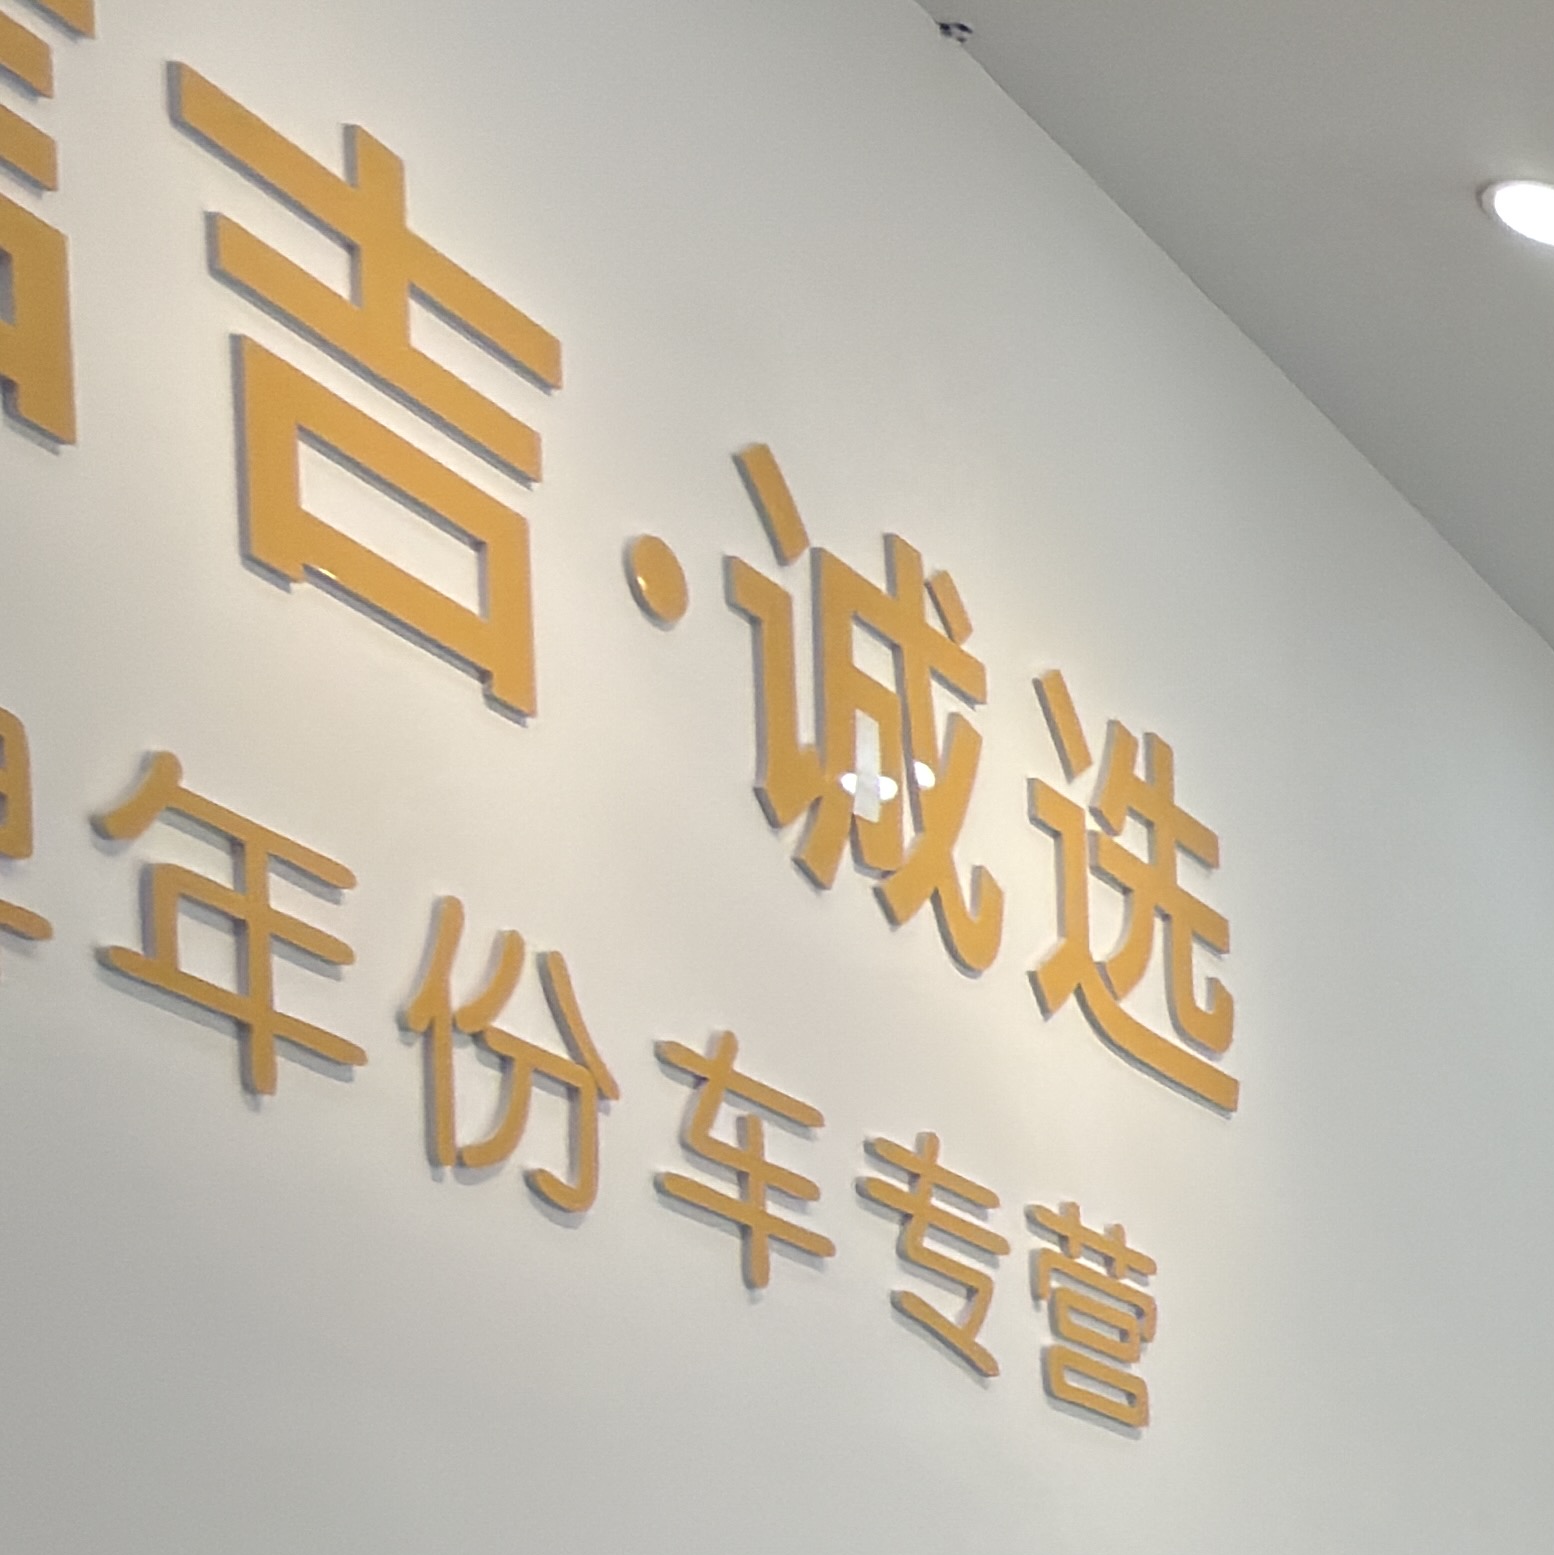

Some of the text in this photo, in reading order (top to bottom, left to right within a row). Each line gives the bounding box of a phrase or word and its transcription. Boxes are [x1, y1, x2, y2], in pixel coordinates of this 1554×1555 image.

[0, 0, 1240, 1114] 吉·诚选
[0, 706, 1160, 1430] 年份车专营
